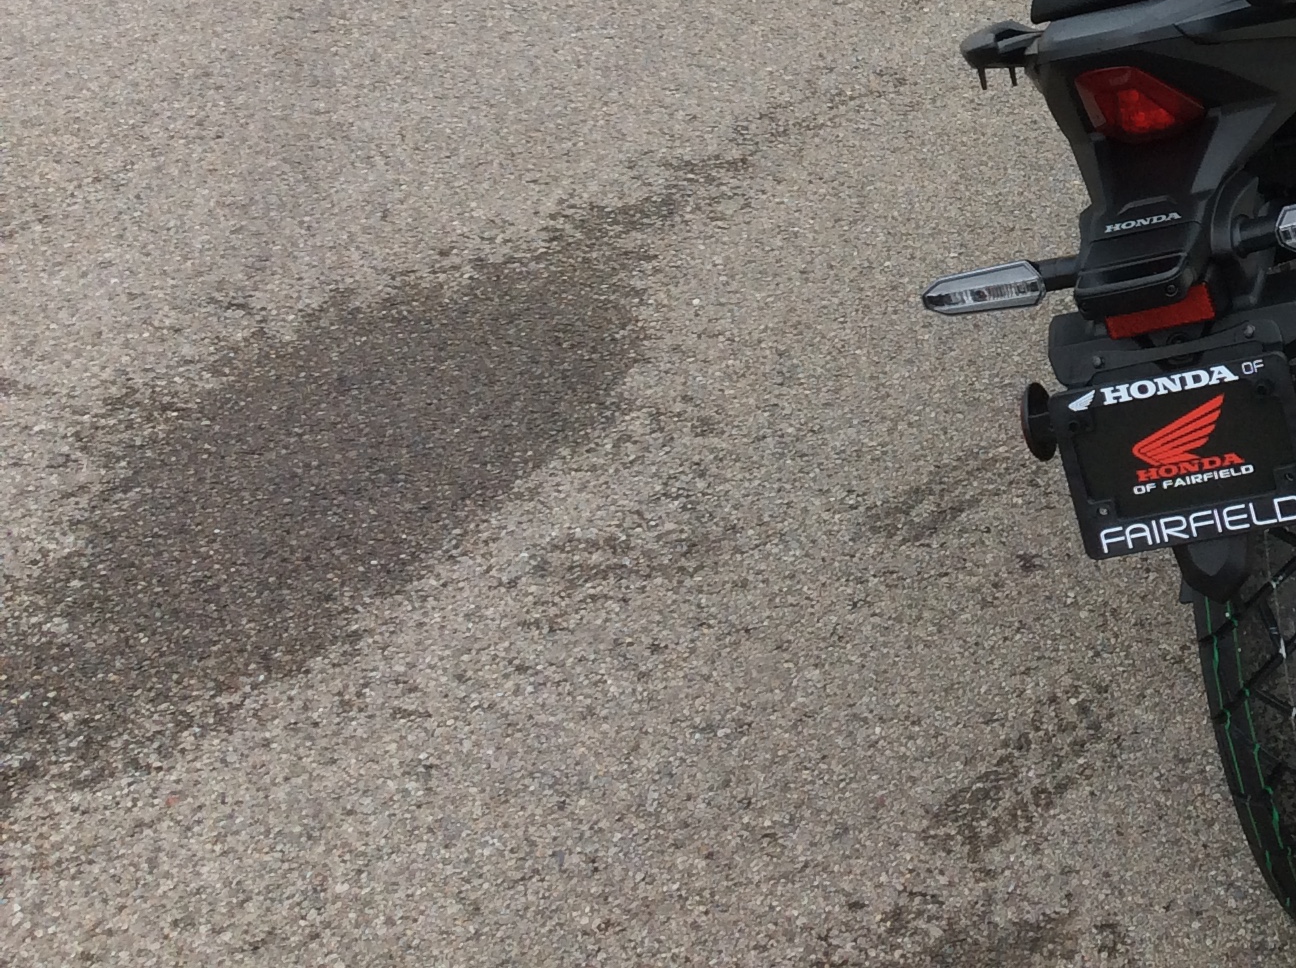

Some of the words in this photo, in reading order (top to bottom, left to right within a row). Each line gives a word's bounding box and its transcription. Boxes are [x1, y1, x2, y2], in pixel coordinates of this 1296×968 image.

[1104, 212, 1182, 233] HONDA
[1100, 365, 1239, 406] HONDA
[1241, 359, 1265, 375] OF
[1133, 481, 1157, 495] OF
[1162, 464, 1255, 490] FAIRFIELD
[1135, 452, 1246, 482] HONDA
